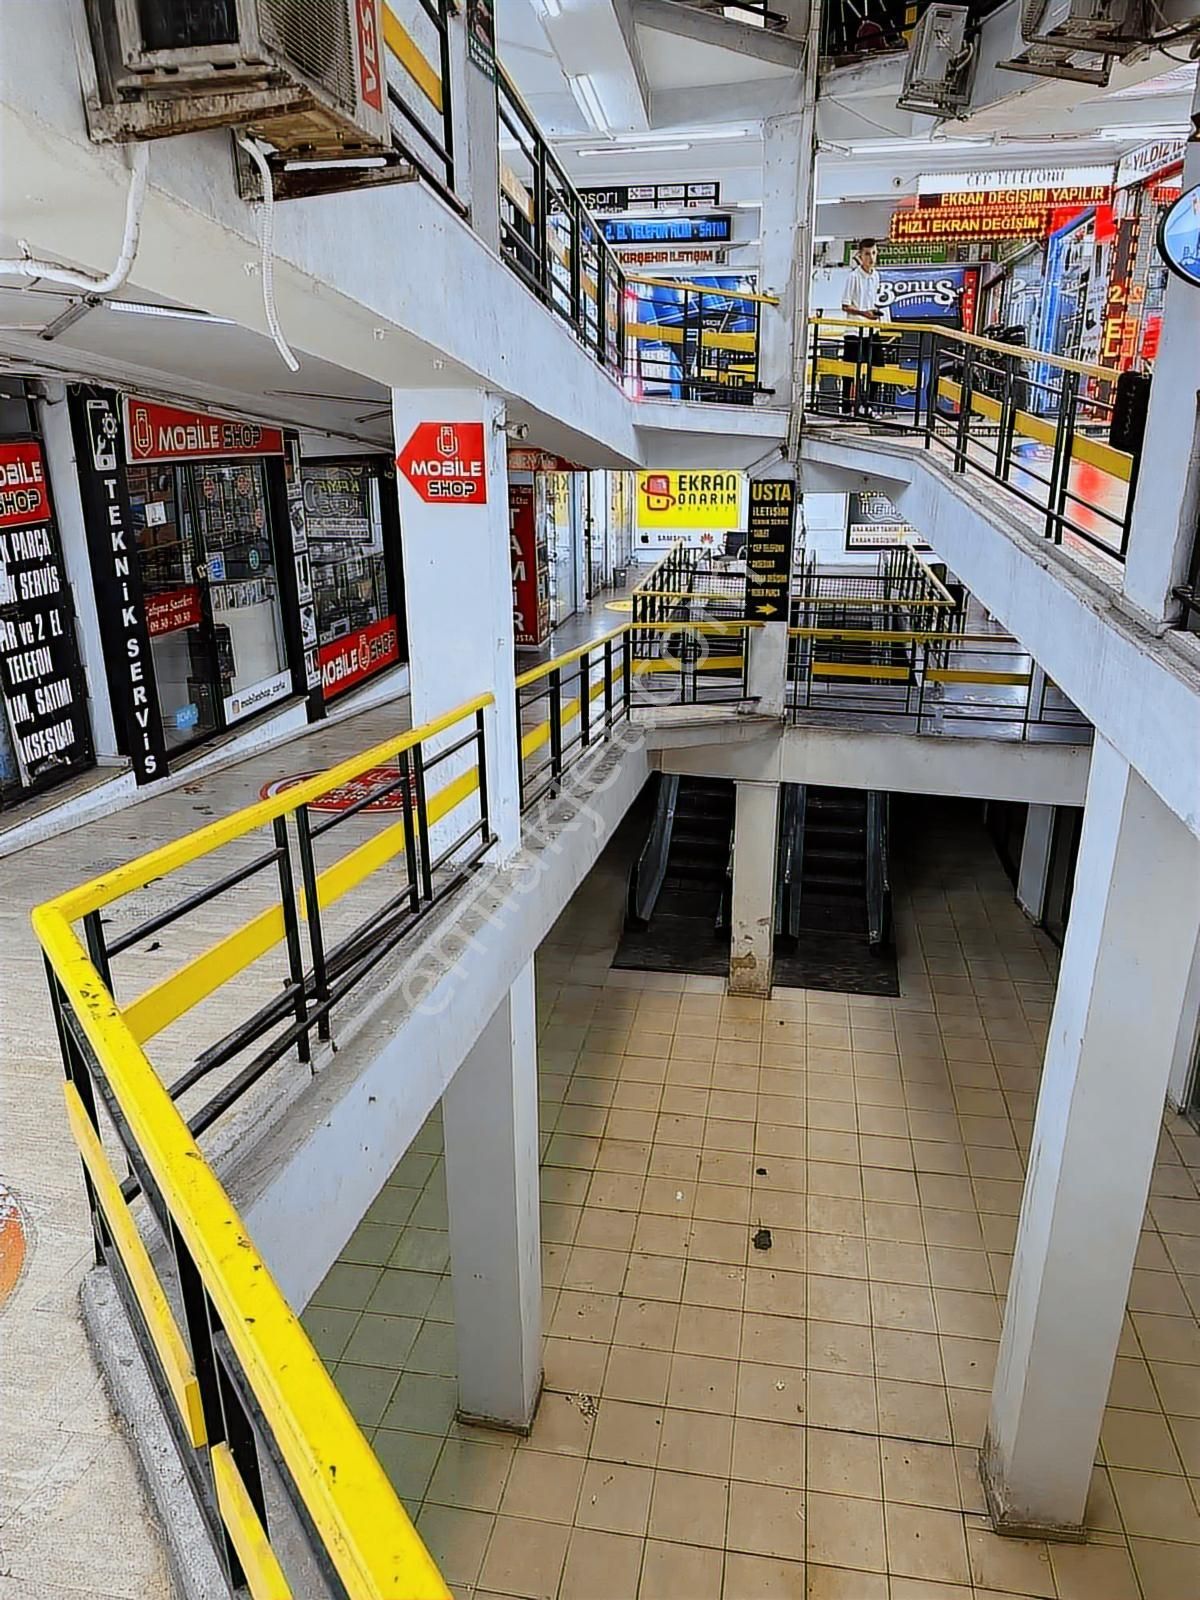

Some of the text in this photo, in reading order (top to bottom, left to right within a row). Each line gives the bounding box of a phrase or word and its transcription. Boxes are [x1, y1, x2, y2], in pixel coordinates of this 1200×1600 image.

[941, 192, 984, 207] EKRAN
[899, 219, 930, 234] HIZLI
[932, 217, 980, 233] EKRAN
[221, 423, 262, 449] SHOP
[411, 456, 482, 477] MOBİLE
[427, 479, 477, 498] SHOP
[678, 474, 737, 492] EKRAN
[752, 483, 792, 501] USTA
[678, 493, 737, 505] ONARIM
[11, 528, 52, 561] PARÇA
[20, 562, 60, 600] SERVİS
[19, 621, 34, 646] ve
[35, 613, 45, 641] 2
[49, 608, 63, 637] EL
[6, 645, 54, 685] TELEFON
[126, 638, 158, 774] SERVİS
